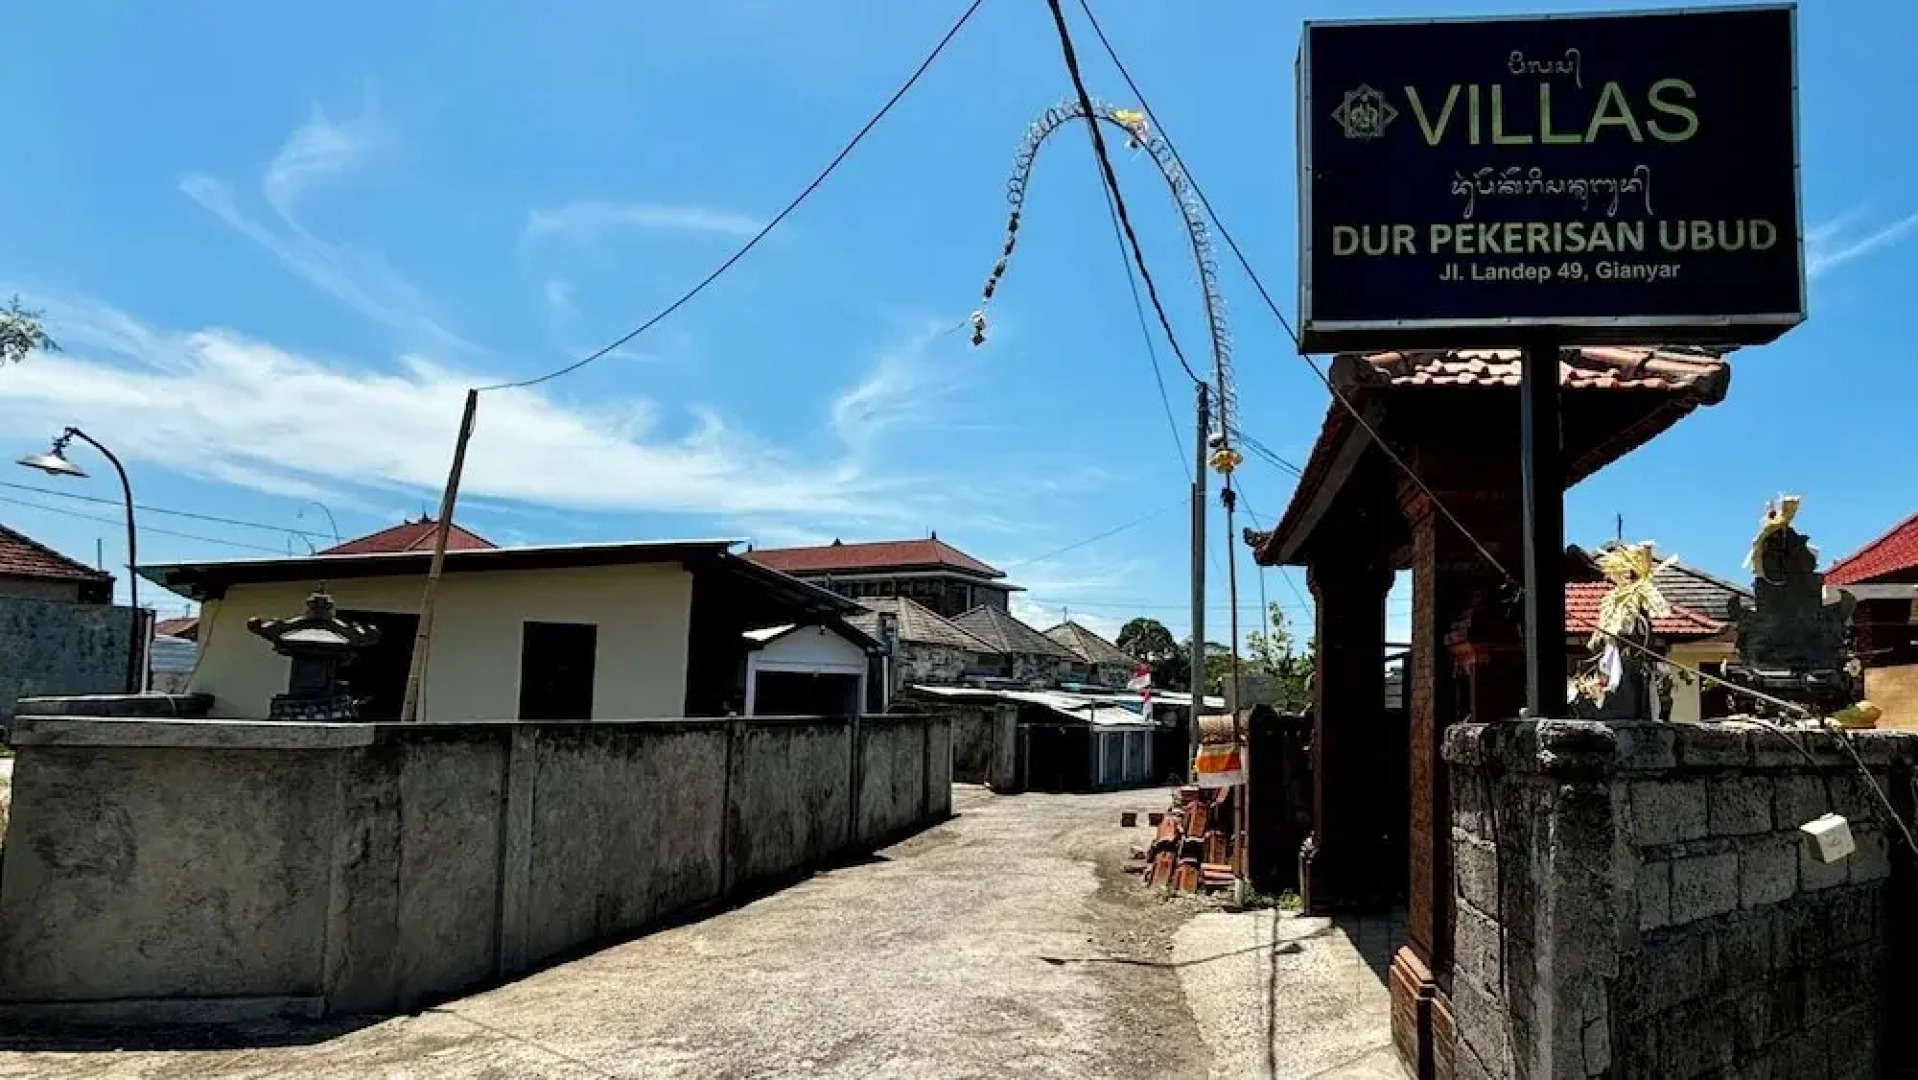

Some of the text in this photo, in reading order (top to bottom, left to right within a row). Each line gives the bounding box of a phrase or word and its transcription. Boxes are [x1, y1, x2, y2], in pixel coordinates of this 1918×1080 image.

[1404, 78, 1700, 147] VILLAS
[1332, 219, 1778, 257] DUR PEKERISAN UBUD
[1438, 260, 1682, 284] Jl. Landep 49, Gianyar
